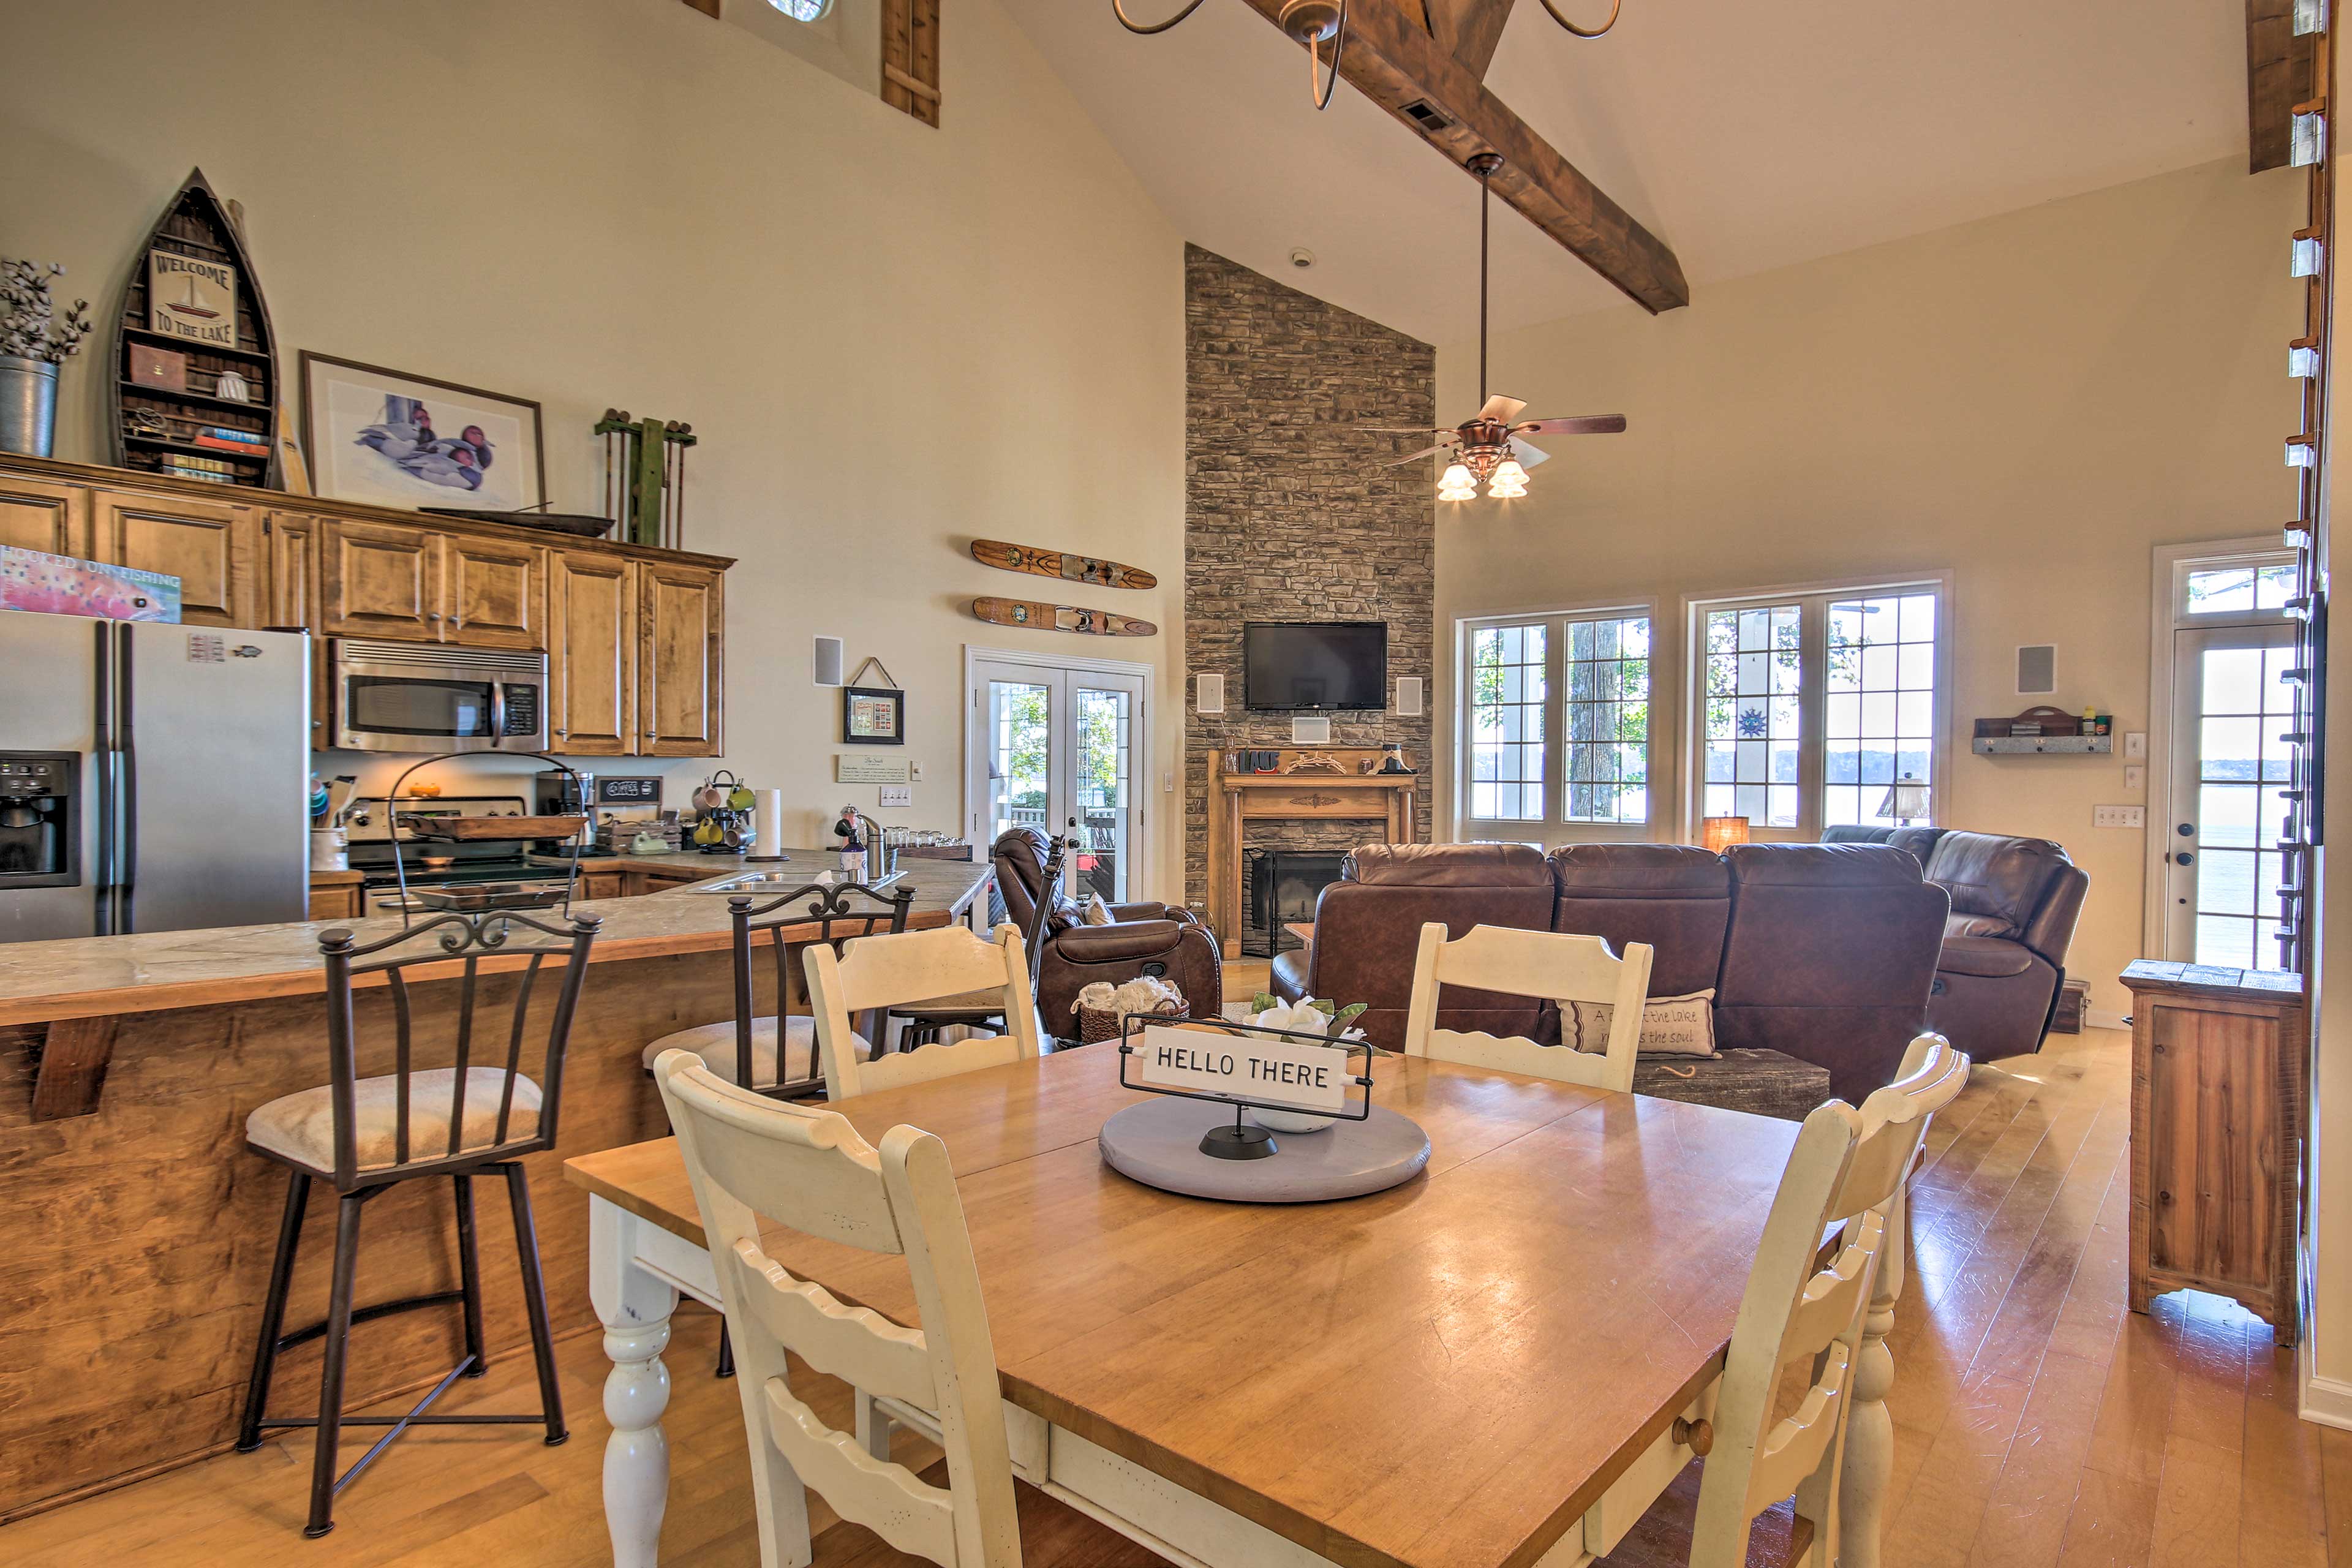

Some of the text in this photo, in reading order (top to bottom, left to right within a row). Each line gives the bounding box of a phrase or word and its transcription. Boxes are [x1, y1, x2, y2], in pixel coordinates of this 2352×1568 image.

[156, 254, 229, 291] WELCOME
[156, 309, 231, 344] TO THE LAKE
[3, 545, 179, 587] HOOKED ON FISHING
[1239, 750, 1280, 774] LAKE
[1594, 1010, 1605, 1022] A
[1651, 1010, 1670, 1022] the
[1672, 1009, 1697, 1022] lake
[1649, 1029, 1667, 1043] the
[1670, 1029, 1694, 1042] soul
[1158, 1046, 1329, 1088] HELLO THERE
